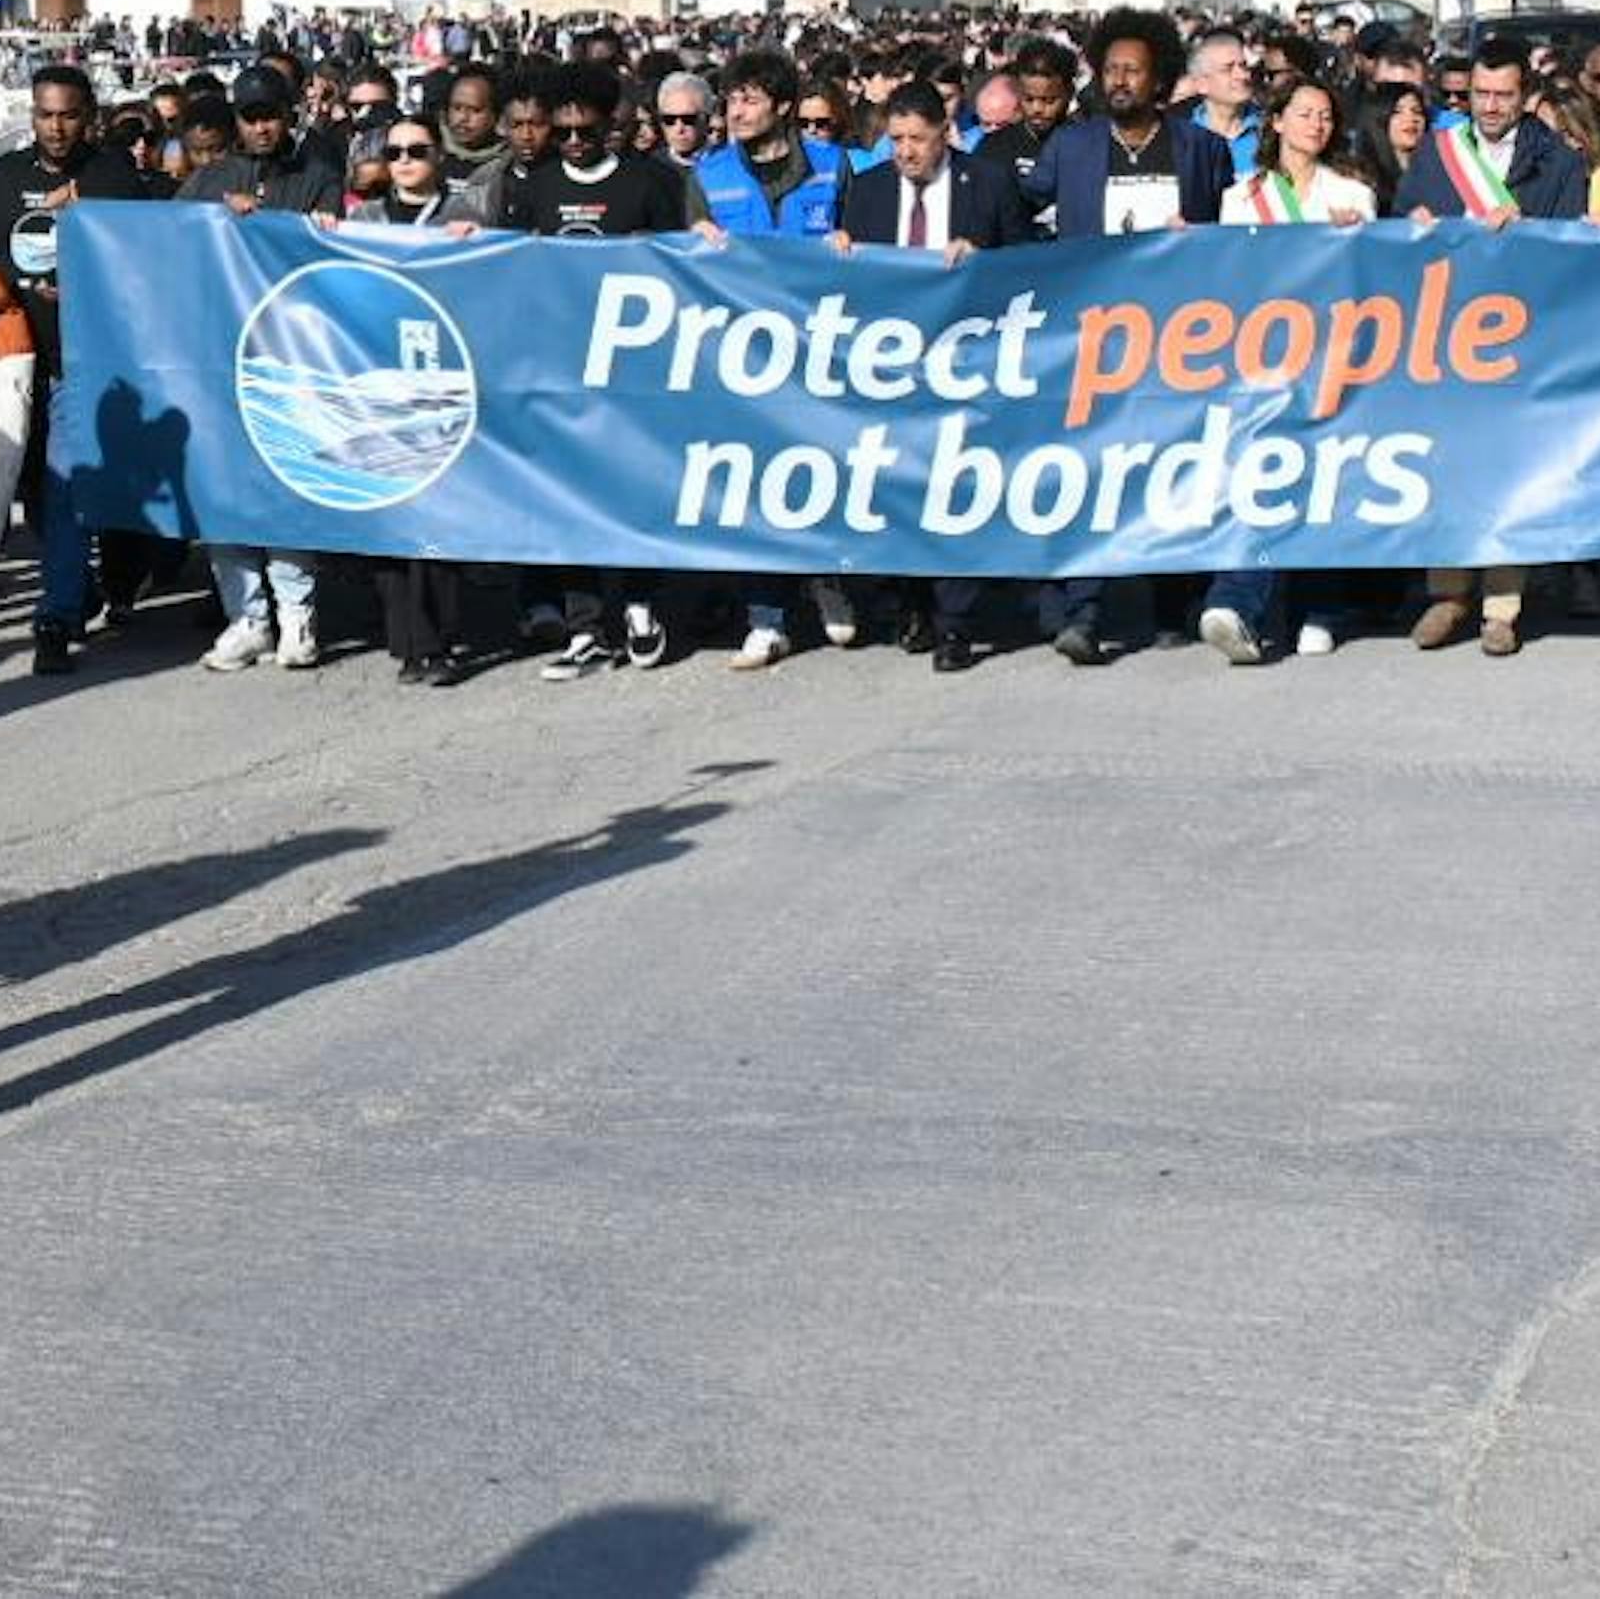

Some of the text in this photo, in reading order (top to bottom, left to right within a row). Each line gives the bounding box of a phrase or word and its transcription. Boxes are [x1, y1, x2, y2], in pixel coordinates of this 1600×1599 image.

[583, 257, 1528, 429] Protect people
[675, 404, 1434, 536] not borders
